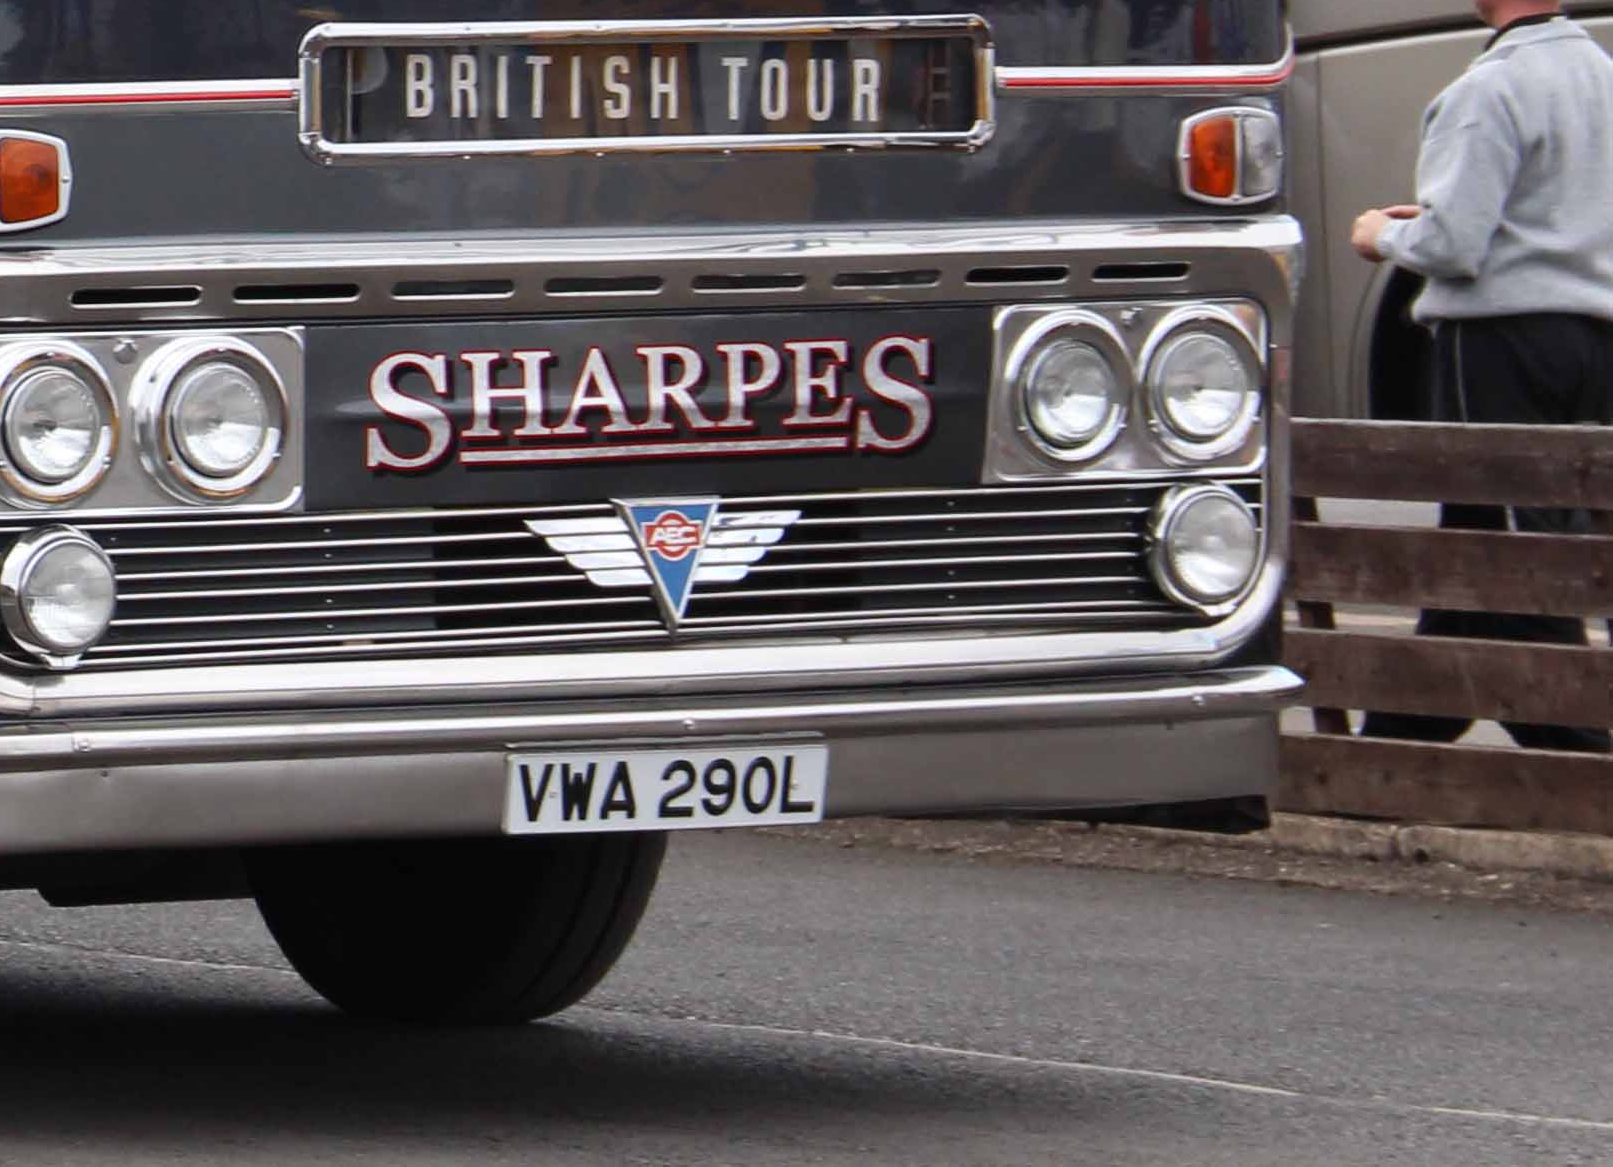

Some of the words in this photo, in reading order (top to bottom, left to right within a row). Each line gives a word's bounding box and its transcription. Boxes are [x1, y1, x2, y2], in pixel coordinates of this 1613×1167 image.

[405, 53, 678, 121] BRITISH
[721, 55, 882, 123] TOUR
[366, 335, 935, 472] SHARPES
[648, 526, 697, 545] AEC
[519, 760, 636, 822] VWA
[657, 755, 815, 818] 290L
